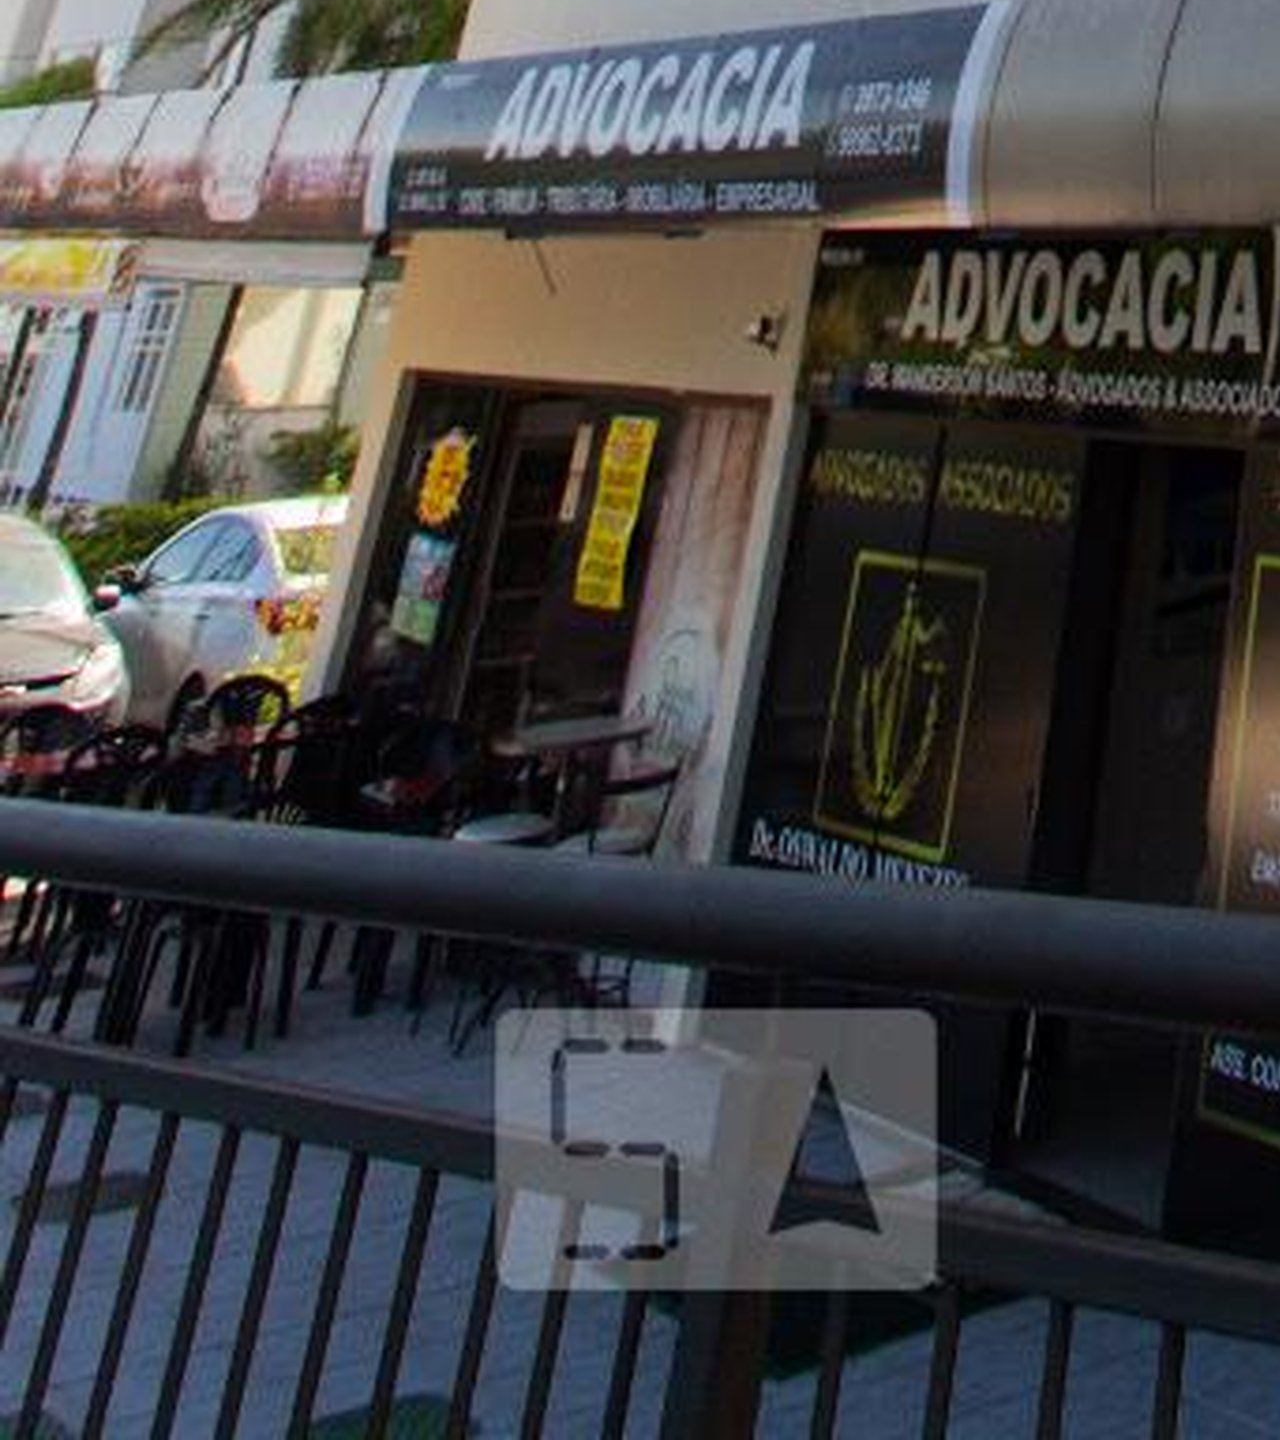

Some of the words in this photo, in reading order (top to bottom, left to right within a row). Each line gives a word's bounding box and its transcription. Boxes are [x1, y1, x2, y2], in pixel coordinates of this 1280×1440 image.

[483, 39, 817, 162] ADVOCACIA
[715, 181, 821, 212] EMPRESARIAL
[901, 245, 1265, 355] ADVOCACIA
